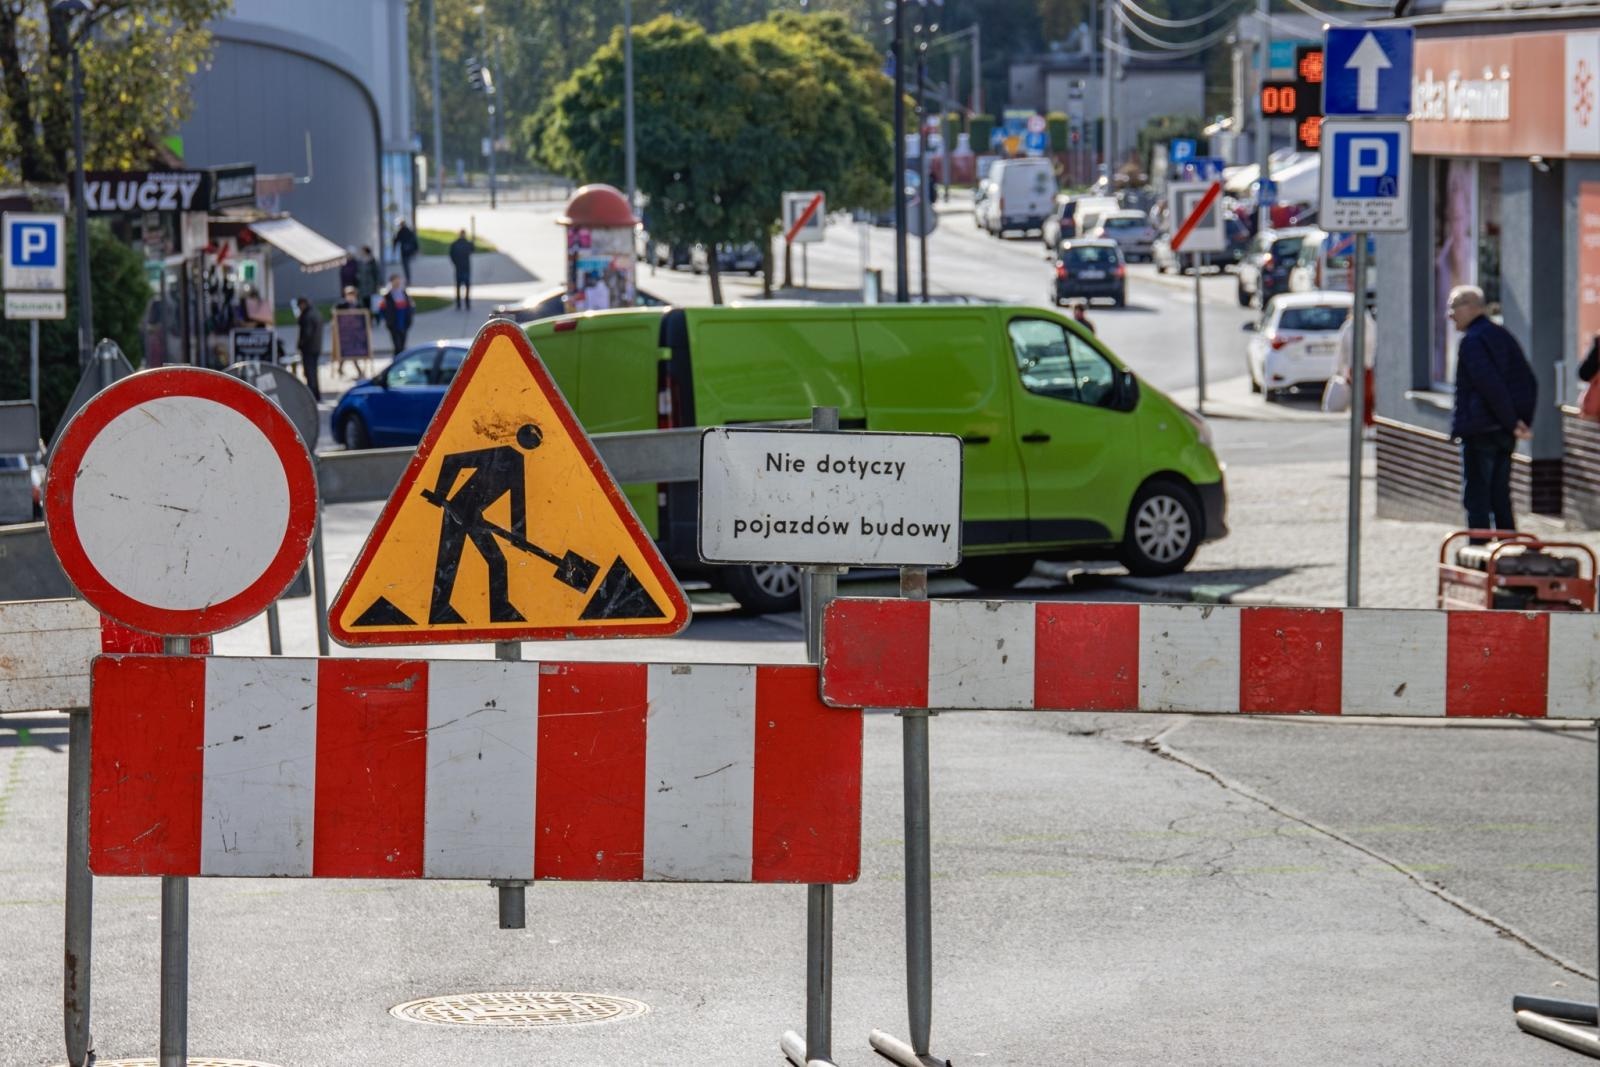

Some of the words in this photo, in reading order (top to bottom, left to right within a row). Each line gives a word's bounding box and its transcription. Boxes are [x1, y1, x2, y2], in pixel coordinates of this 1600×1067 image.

[1262, 86, 1296, 114] 00
[1348, 138, 1388, 193] P
[83, 181, 201, 211] KLUCZY
[21, 227, 47, 262] P
[766, 452, 805, 473] Nie
[817, 454, 906, 481] dotyczy
[734, 514, 849, 539] pojazdów
[861, 517, 951, 543] budowy
